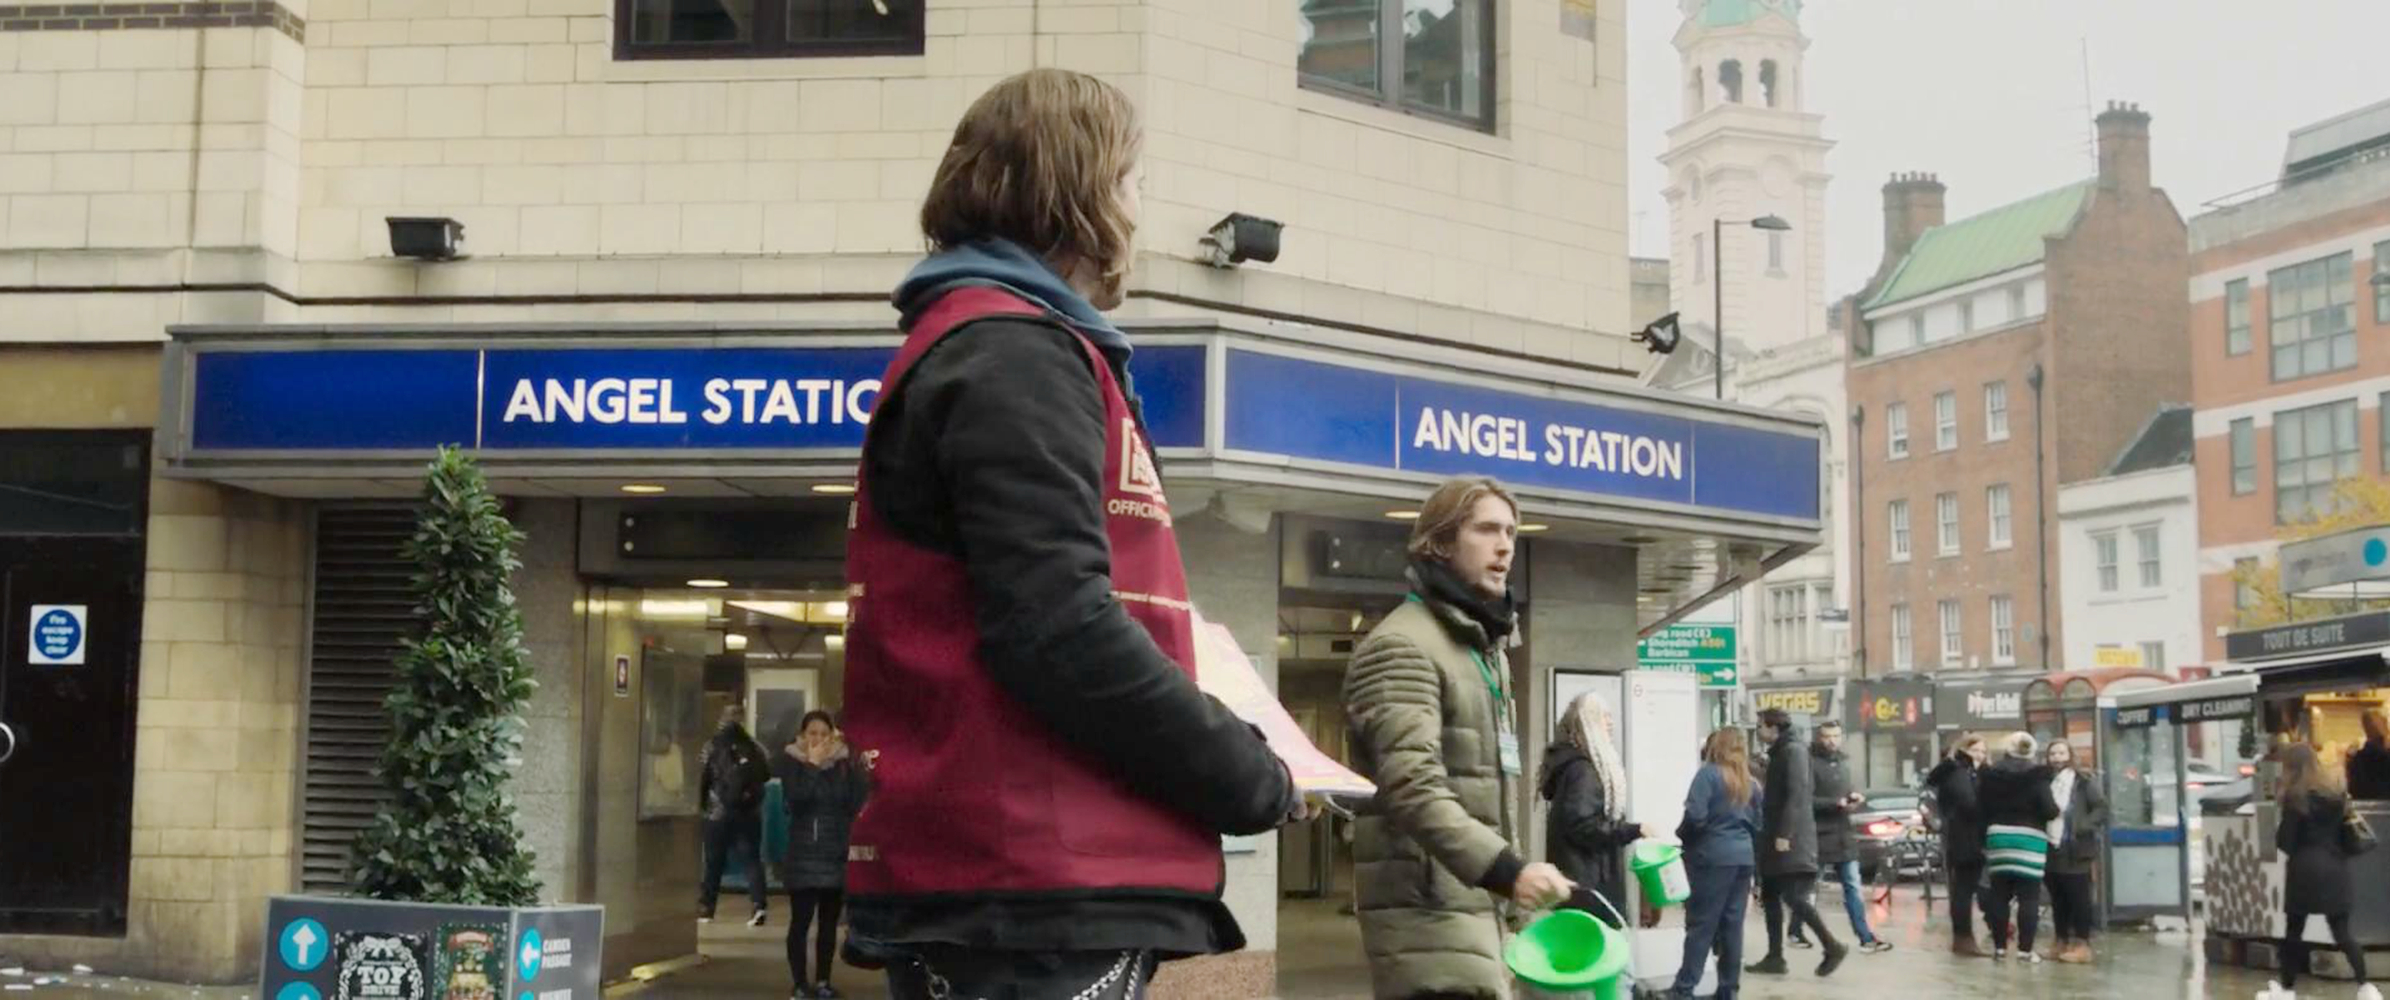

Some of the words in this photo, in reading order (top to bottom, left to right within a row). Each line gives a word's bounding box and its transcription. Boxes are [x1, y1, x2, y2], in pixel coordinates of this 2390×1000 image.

[503, 378, 687, 424] ANGEL
[701, 378, 883, 424] STATIO
[1413, 406, 1537, 462] ANGEL
[1544, 423, 1682, 480] STATION
[1647, 637, 1699, 648] Shoreditch
[2262, 631, 2292, 651] TOUT
[2311, 623, 2346, 645] SUITE
[1647, 647, 1690, 658] Barbican
[1756, 692, 1819, 713] VEGAS
[357, 966, 407, 985] TOY
